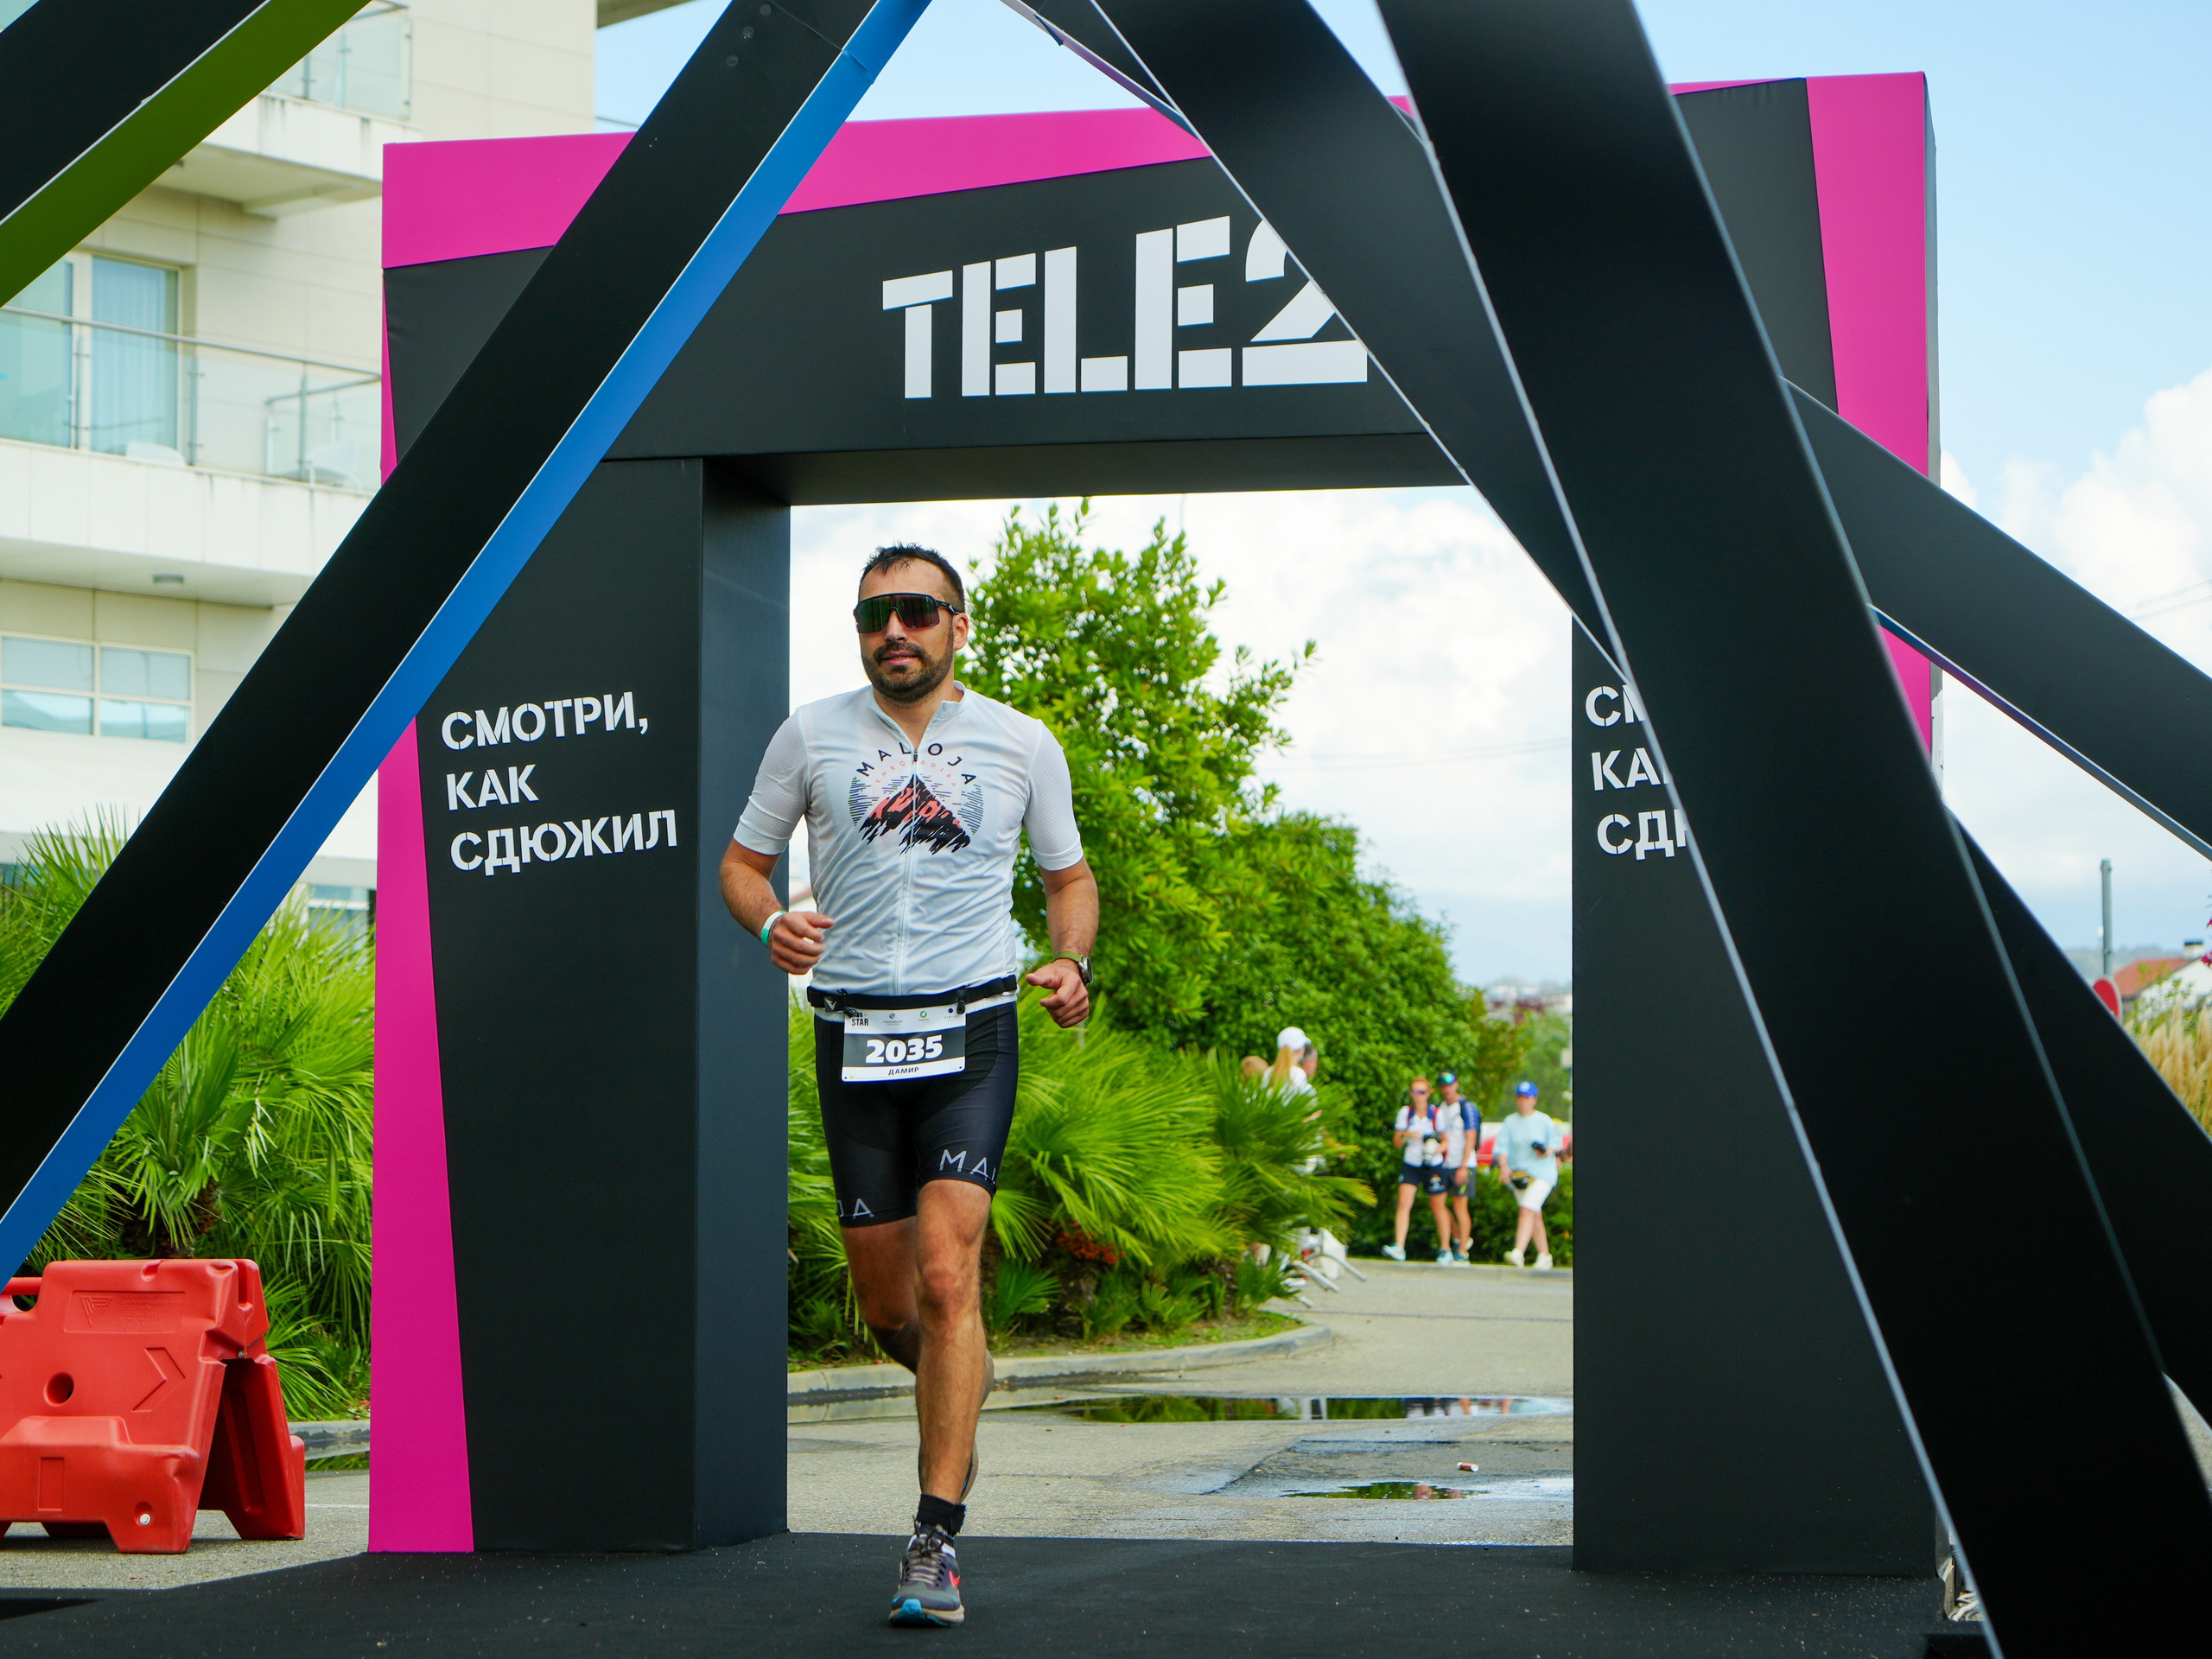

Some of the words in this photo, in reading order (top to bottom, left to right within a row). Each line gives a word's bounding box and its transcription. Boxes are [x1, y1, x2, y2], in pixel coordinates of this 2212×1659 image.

[882, 215, 1369, 399] TELE2
[441, 690, 648, 751] СМОТРИ,
[855, 741, 977, 785] MALOJA
[1591, 747, 1673, 791] КА
[446, 763, 540, 811] КАК
[450, 809, 677, 877] СДЮЖИЛ
[851, 1018, 869, 1027] STAR
[865, 1034, 943, 1064] 2035
[887, 1066, 919, 1076] ДАМИР
